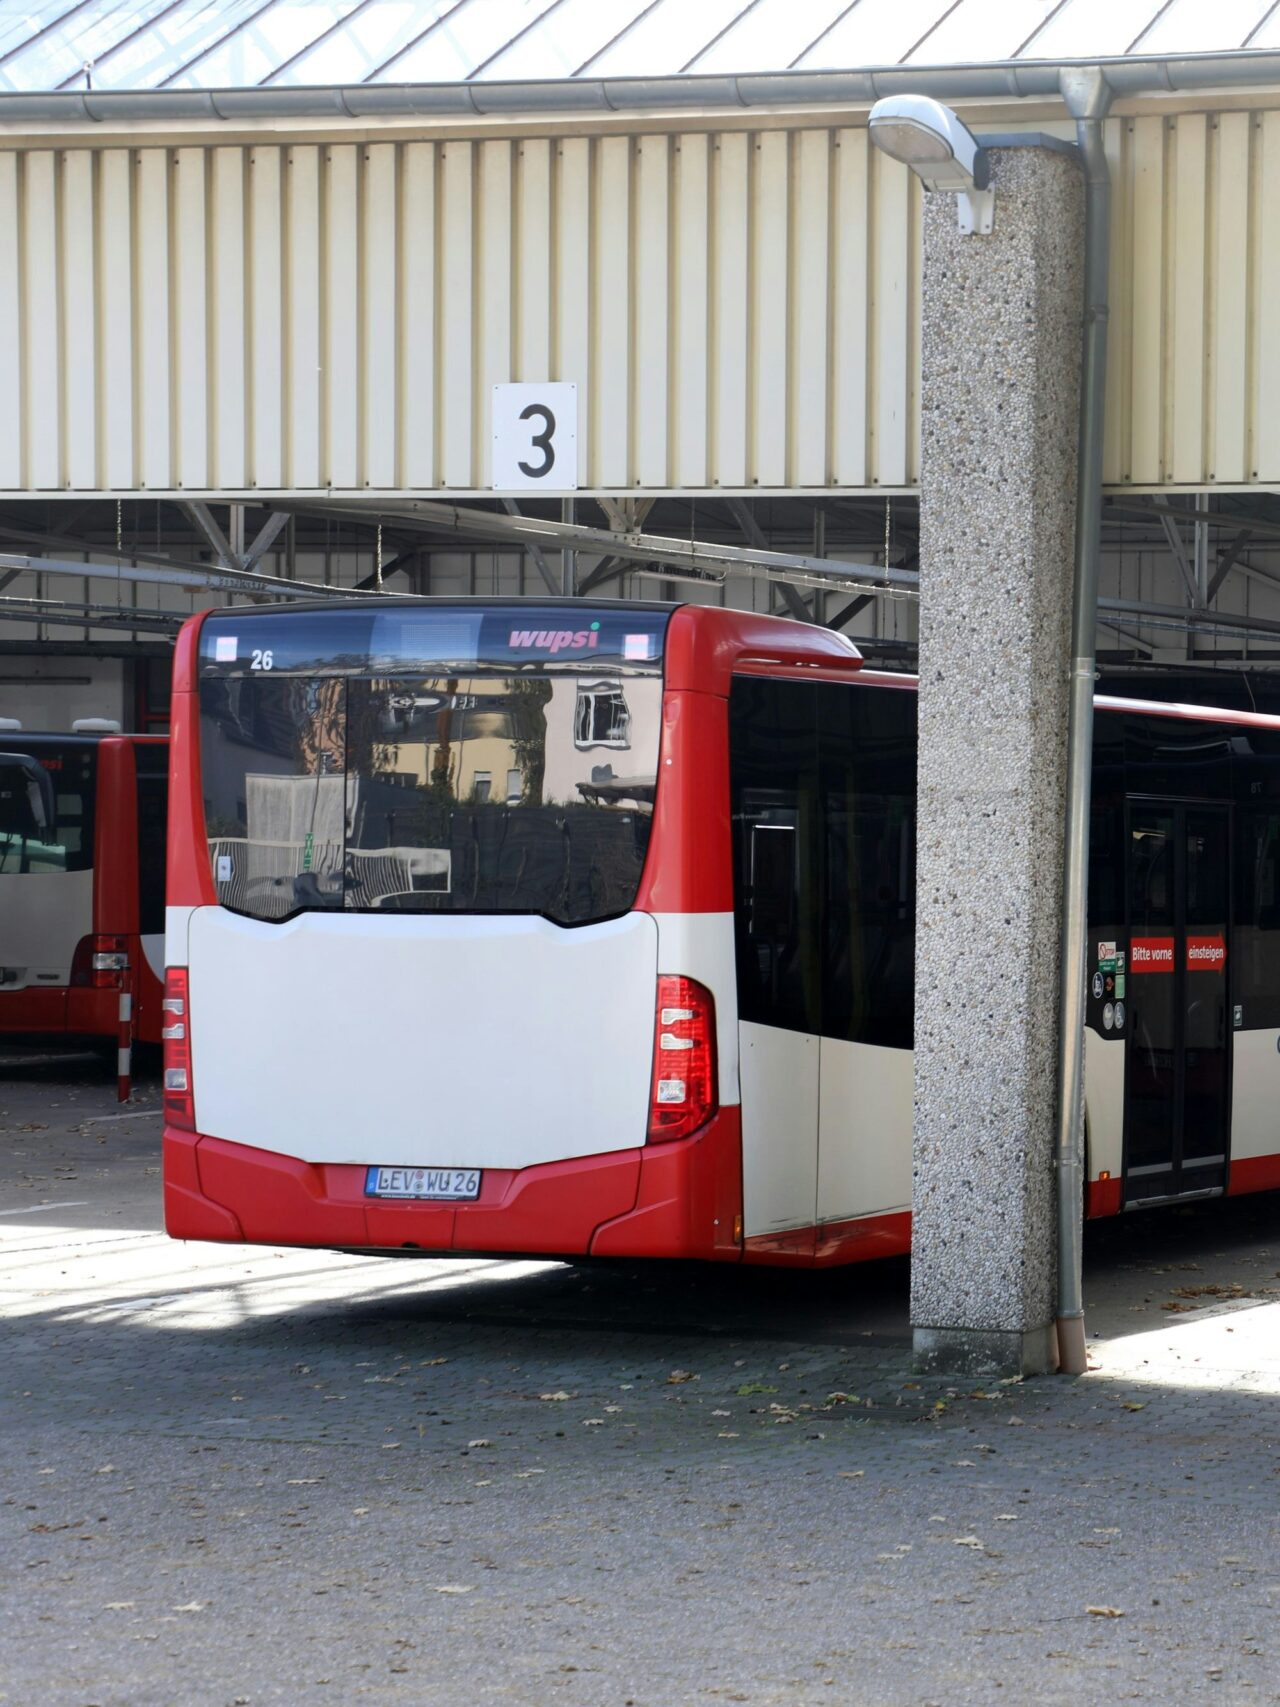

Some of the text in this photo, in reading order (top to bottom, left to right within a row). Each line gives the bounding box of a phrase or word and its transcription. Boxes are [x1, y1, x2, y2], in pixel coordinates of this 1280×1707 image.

[517, 403, 556, 478] 3
[509, 622, 600, 653] wupsi
[250, 649, 273, 671] 26
[1132, 945, 1224, 962] Bitte vorne einsteigen
[378, 1170, 477, 1193] LEV WU 26
